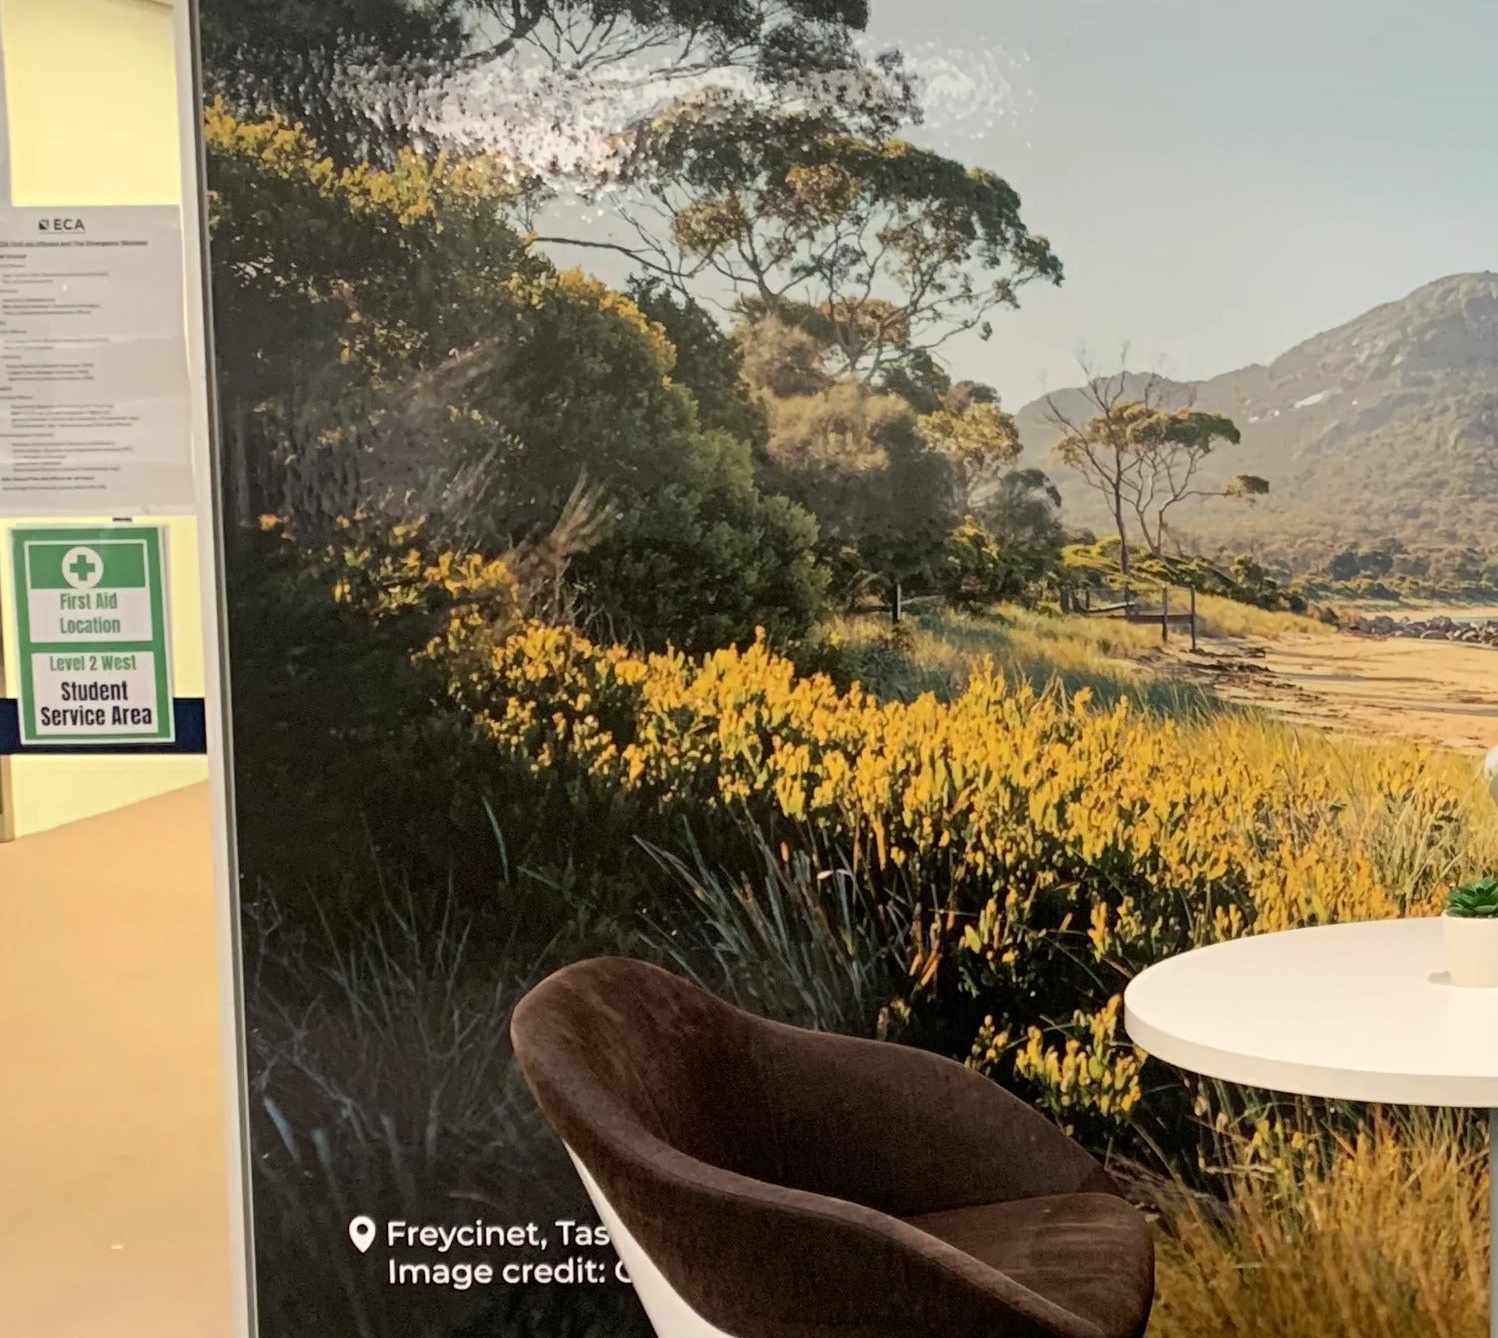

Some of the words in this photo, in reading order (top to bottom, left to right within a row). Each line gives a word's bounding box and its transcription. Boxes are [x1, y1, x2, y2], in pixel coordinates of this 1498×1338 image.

[53, 219, 85, 230] ECA
[60, 592, 91, 610] First
[96, 592, 117, 609] Aid
[60, 617, 121, 634] Location
[50, 655, 84, 671] Level
[90, 656, 97, 671] 2
[101, 655, 136, 670] West
[61, 681, 128, 701] Student
[41, 705, 105, 726] Service
[112, 707, 152, 725] Area
[388, 1219, 547, 1252] Freycinet,
[388, 1260, 493, 1290] Image
[502, 1257, 606, 1284] credit:
